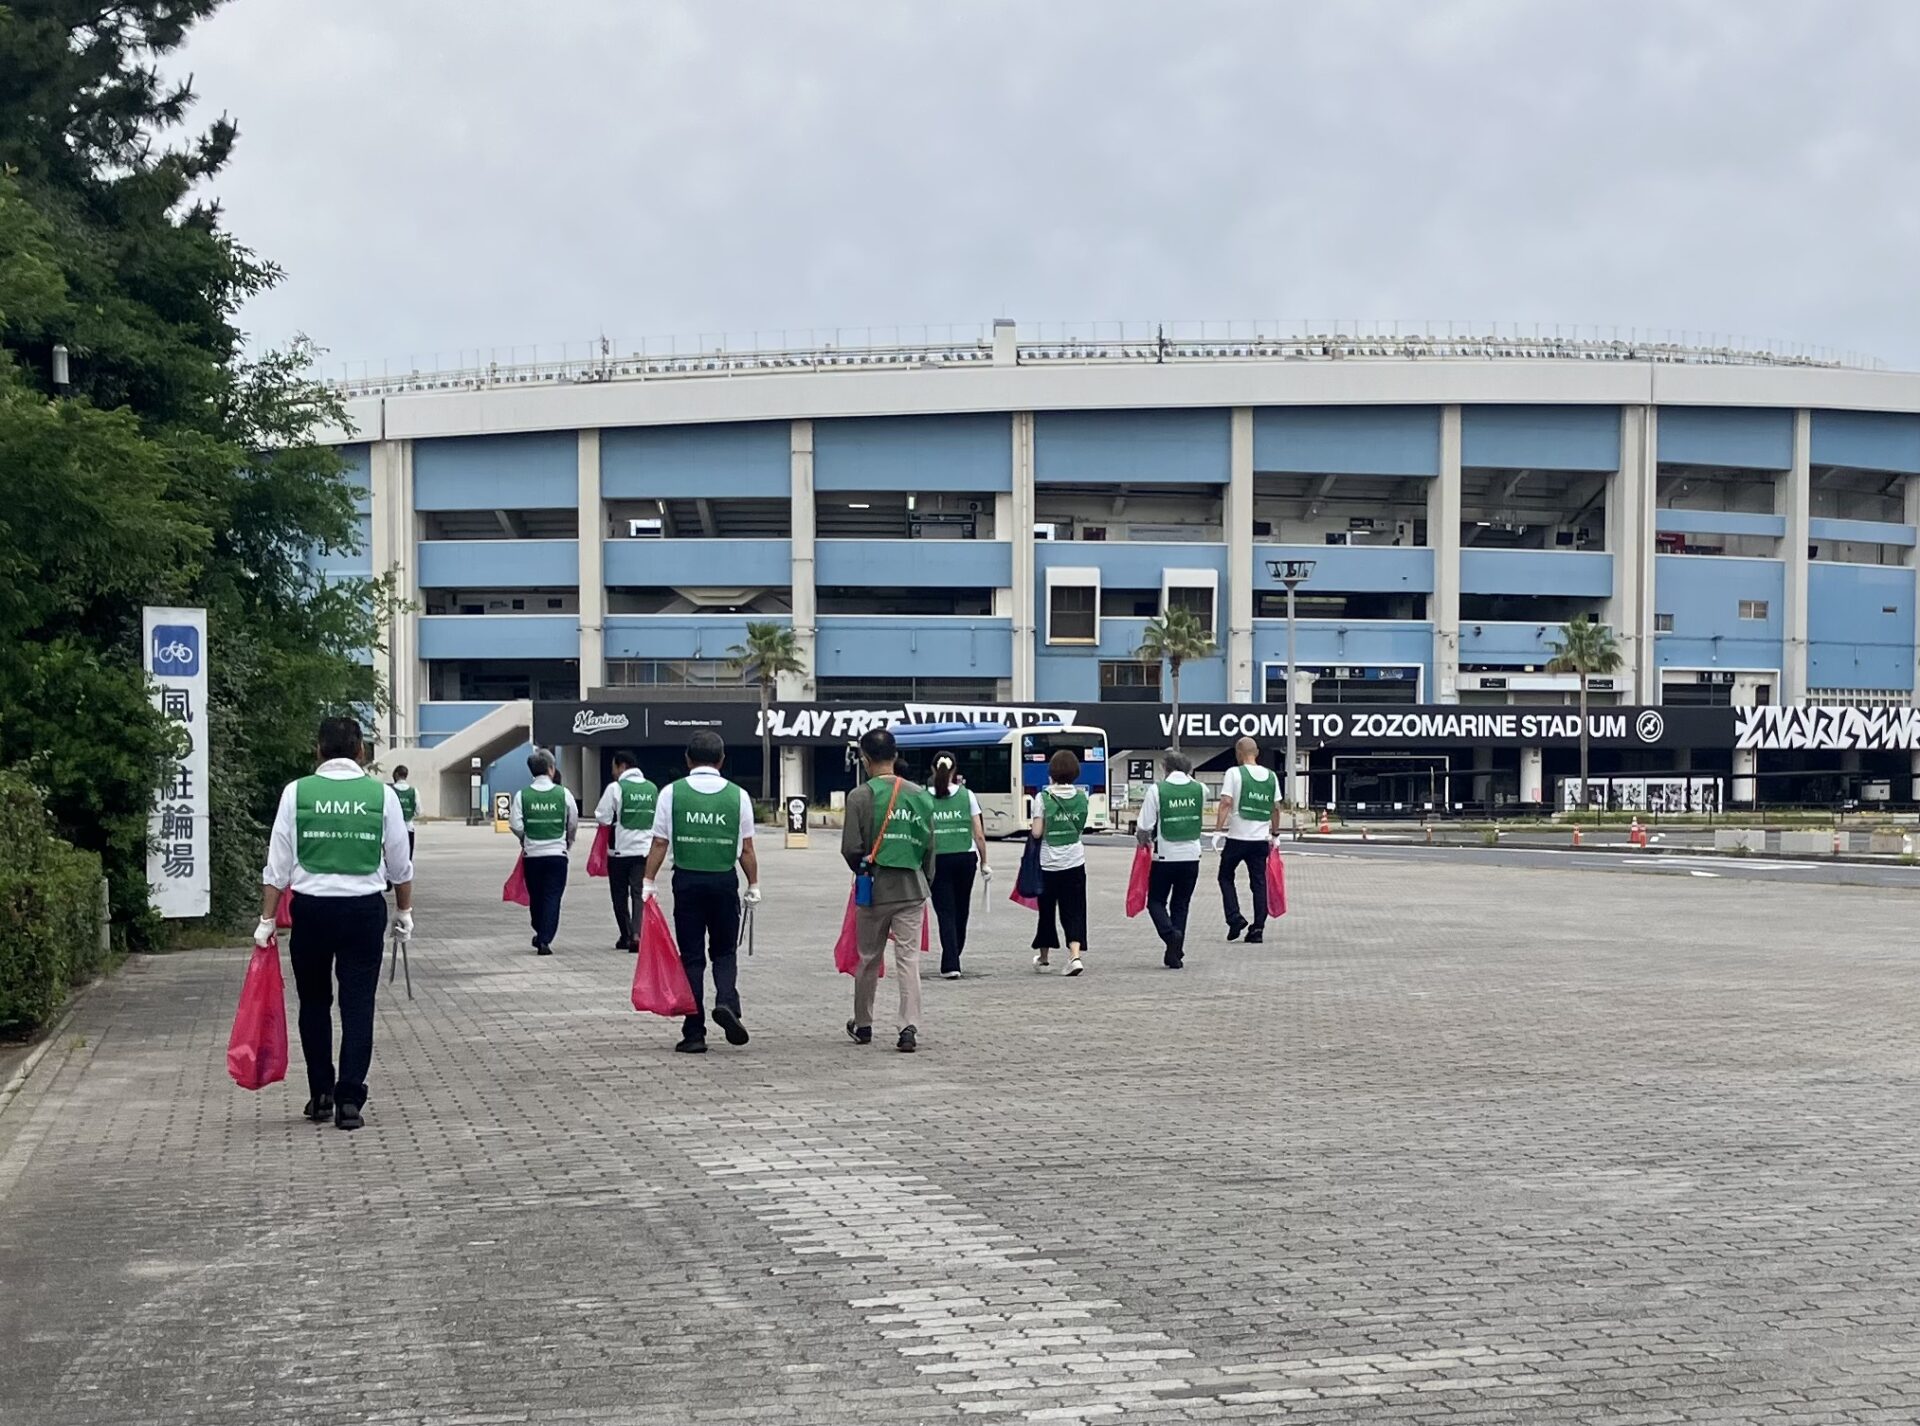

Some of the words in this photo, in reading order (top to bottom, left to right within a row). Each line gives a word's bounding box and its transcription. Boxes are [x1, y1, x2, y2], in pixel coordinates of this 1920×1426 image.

[755, 710, 831, 737] PLAY
[1159, 713, 1302, 737] WELCOME
[1307, 714, 1344, 737] TO
[1351, 714, 1517, 737] ZOZOMARINE
[1521, 714, 1626, 738] STADUM
[1130, 761, 1140, 773] F
[630, 793, 653, 802] MMK
[1249, 791, 1270, 802] MMK
[315, 800, 367, 815] MMK
[531, 802, 557, 811] MMK
[1169, 798, 1196, 809] MMK
[686, 811, 727, 826] MMK
[933, 810, 962, 820] MMK
